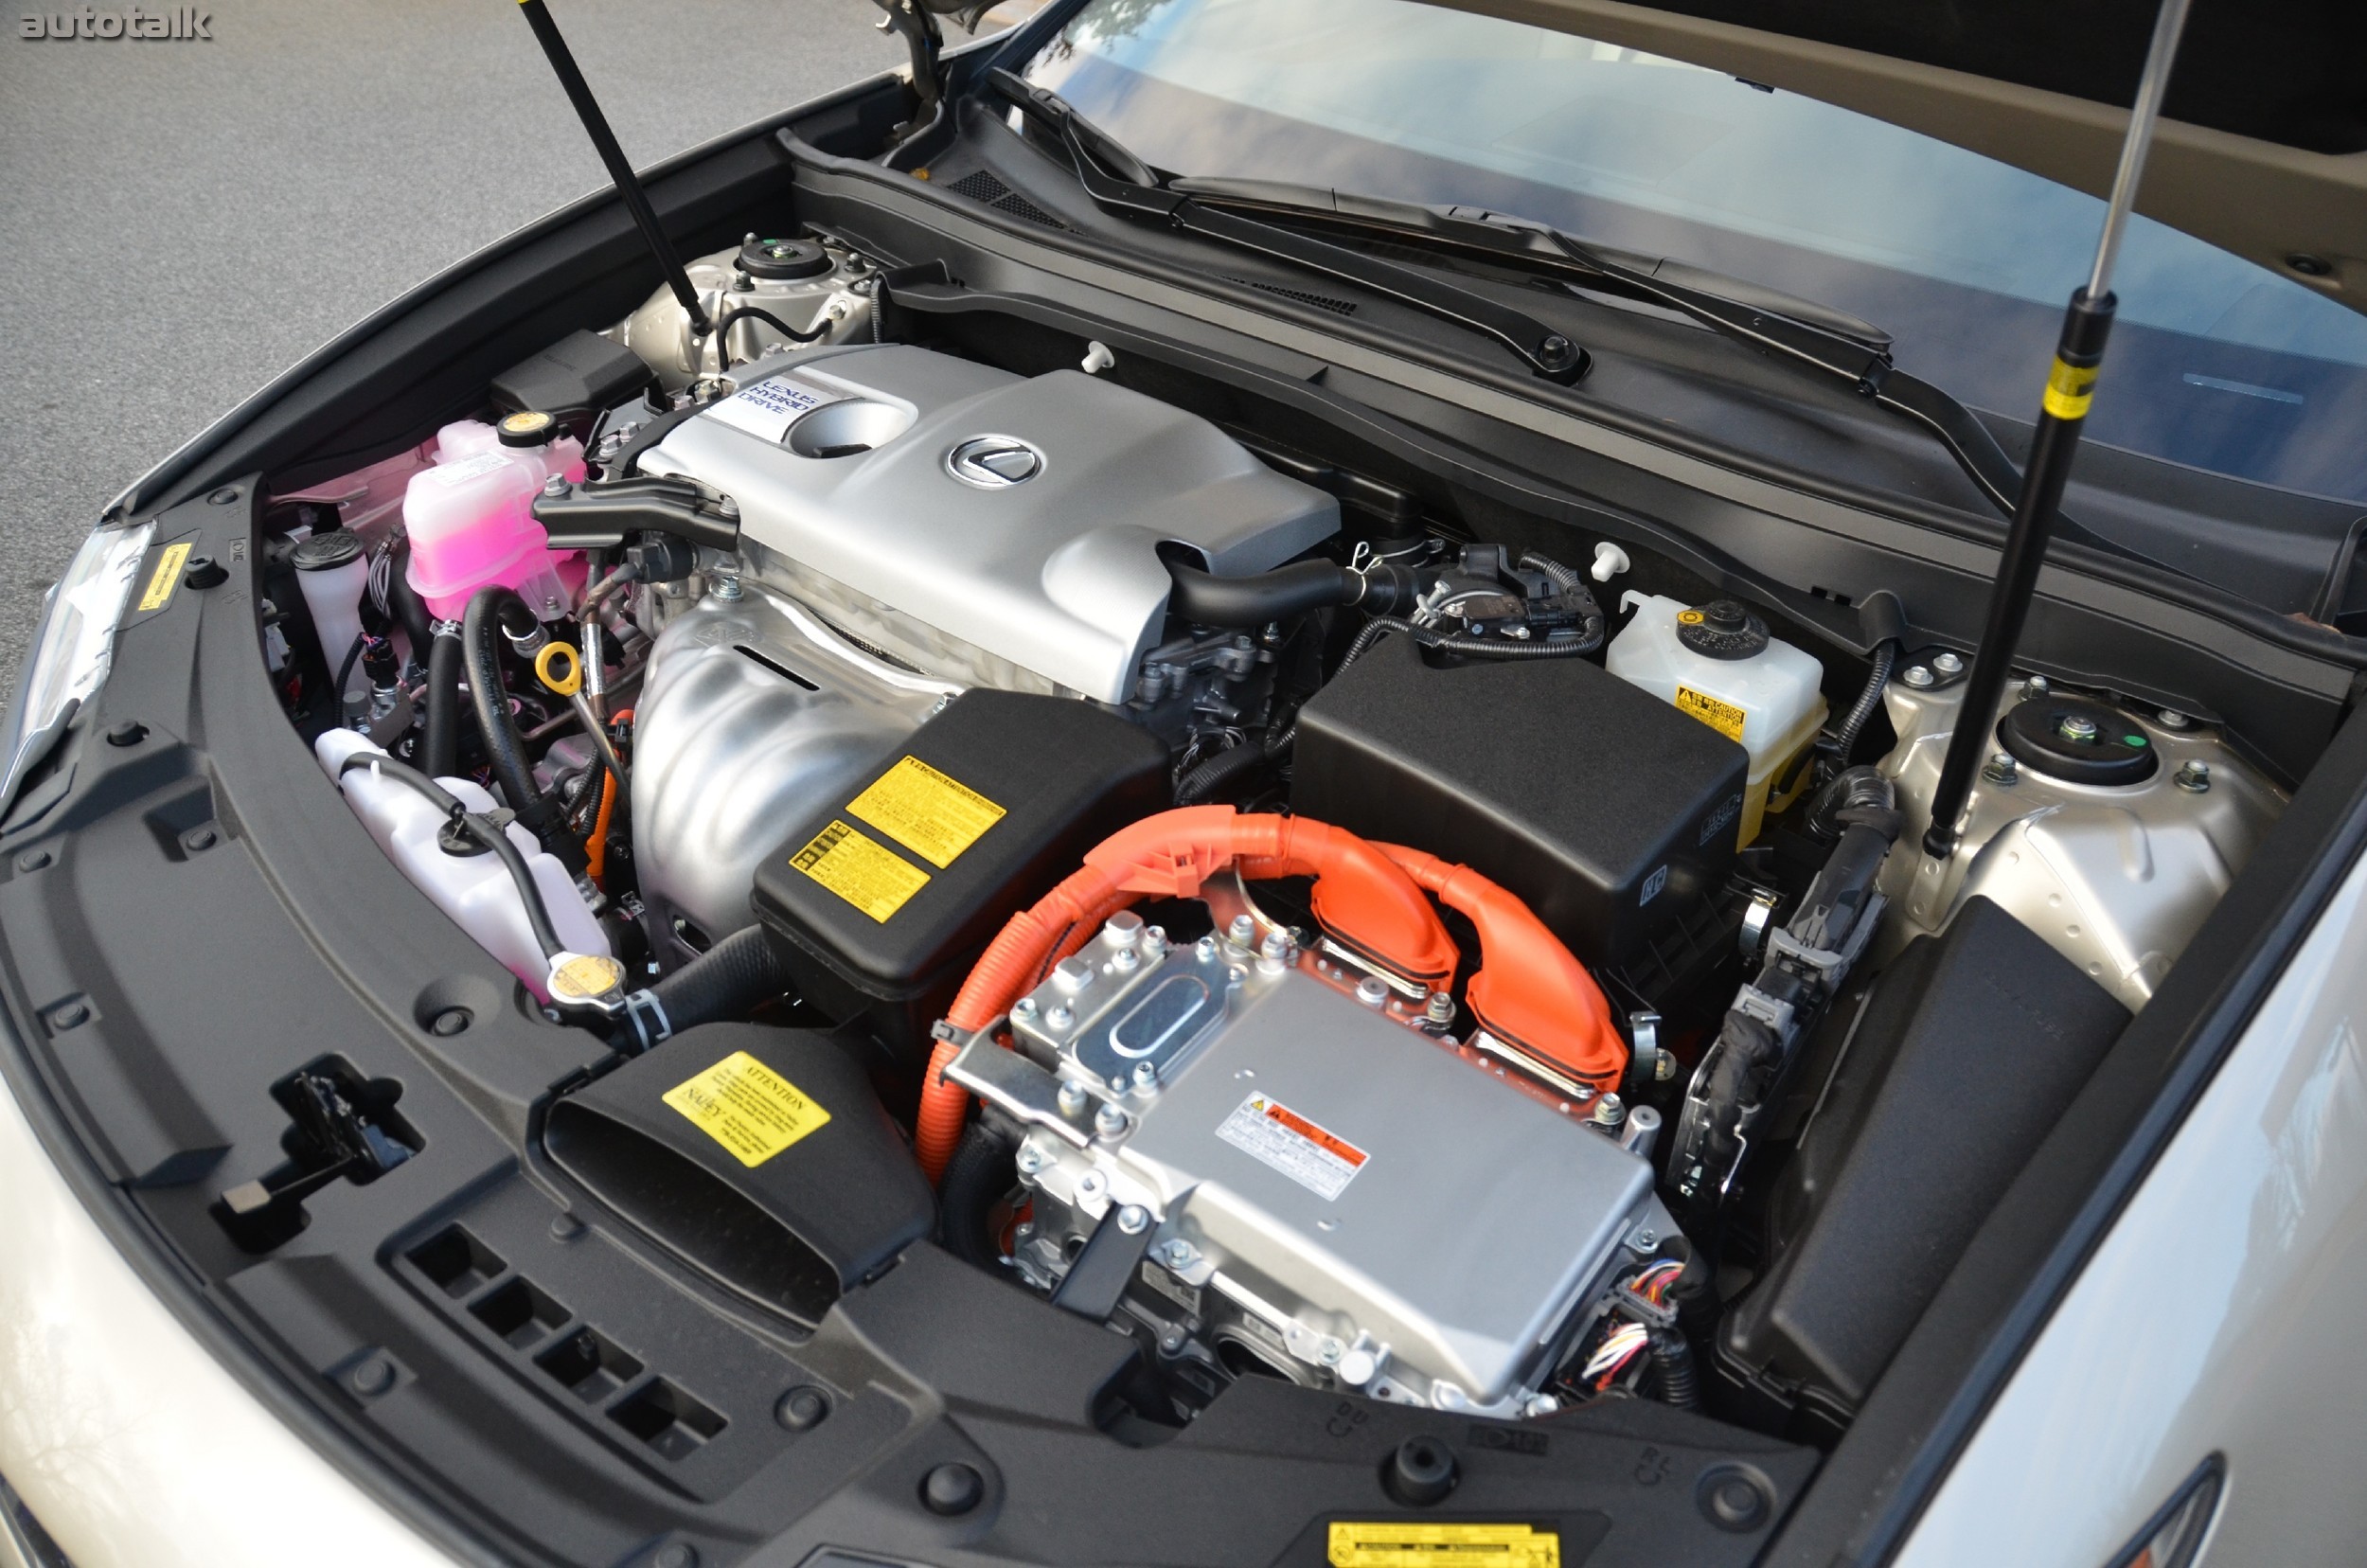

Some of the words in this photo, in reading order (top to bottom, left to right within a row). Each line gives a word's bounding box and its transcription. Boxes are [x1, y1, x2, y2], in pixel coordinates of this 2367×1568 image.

[738, 392, 789, 415] DRIVE
[750, 387, 810, 411] HYBRID
[763, 381, 819, 404] LEXUS
[1707, 704, 1742, 722] ATTENTION
[1715, 703, 1742, 717] CAUTION
[744, 1066, 805, 1111] ATTENTION
